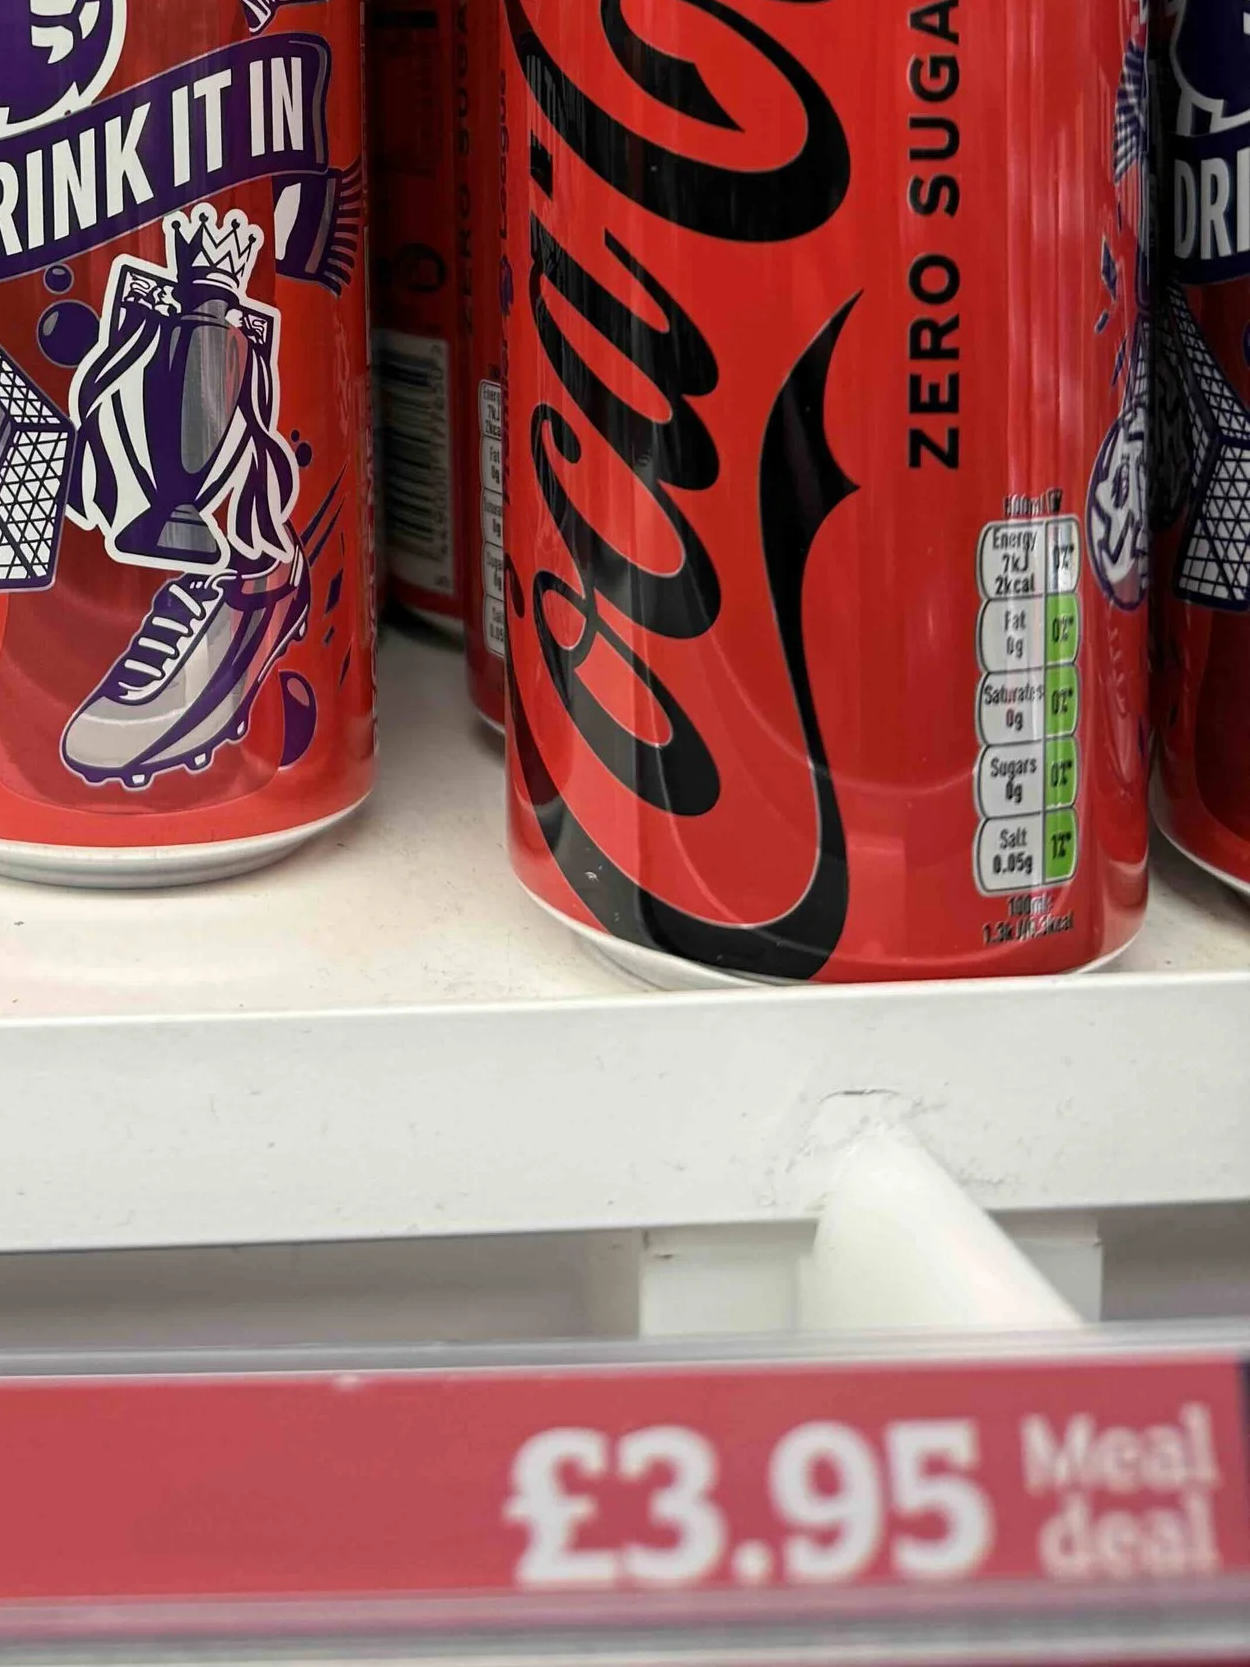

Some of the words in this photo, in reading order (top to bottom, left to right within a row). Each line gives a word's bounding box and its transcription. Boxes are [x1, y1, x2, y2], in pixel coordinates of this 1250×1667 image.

[172, 72, 232, 187] IT
[249, 56, 305, 157] IN
[1174, 147, 1250, 260] DRI
[908, 253, 960, 471] ZERO
[992, 526, 1037, 553] Energy
[995, 573, 1035, 595] 2kcal
[1005, 610, 1026, 632] Fat
[1006, 636, 1023, 658] 0g
[984, 682, 1044, 705] Saturates
[1006, 709, 1023, 732] 0g
[990, 757, 1037, 782] Sugars
[1005, 781, 1022, 804] 0g
[1000, 827, 1027, 850] Salt
[993, 852, 1033, 875] 0.05g
[502, 1418, 996, 1589] £3.95
[1021, 1401, 1220, 1494] Meal
[1039, 1492, 1218, 1578] deal
